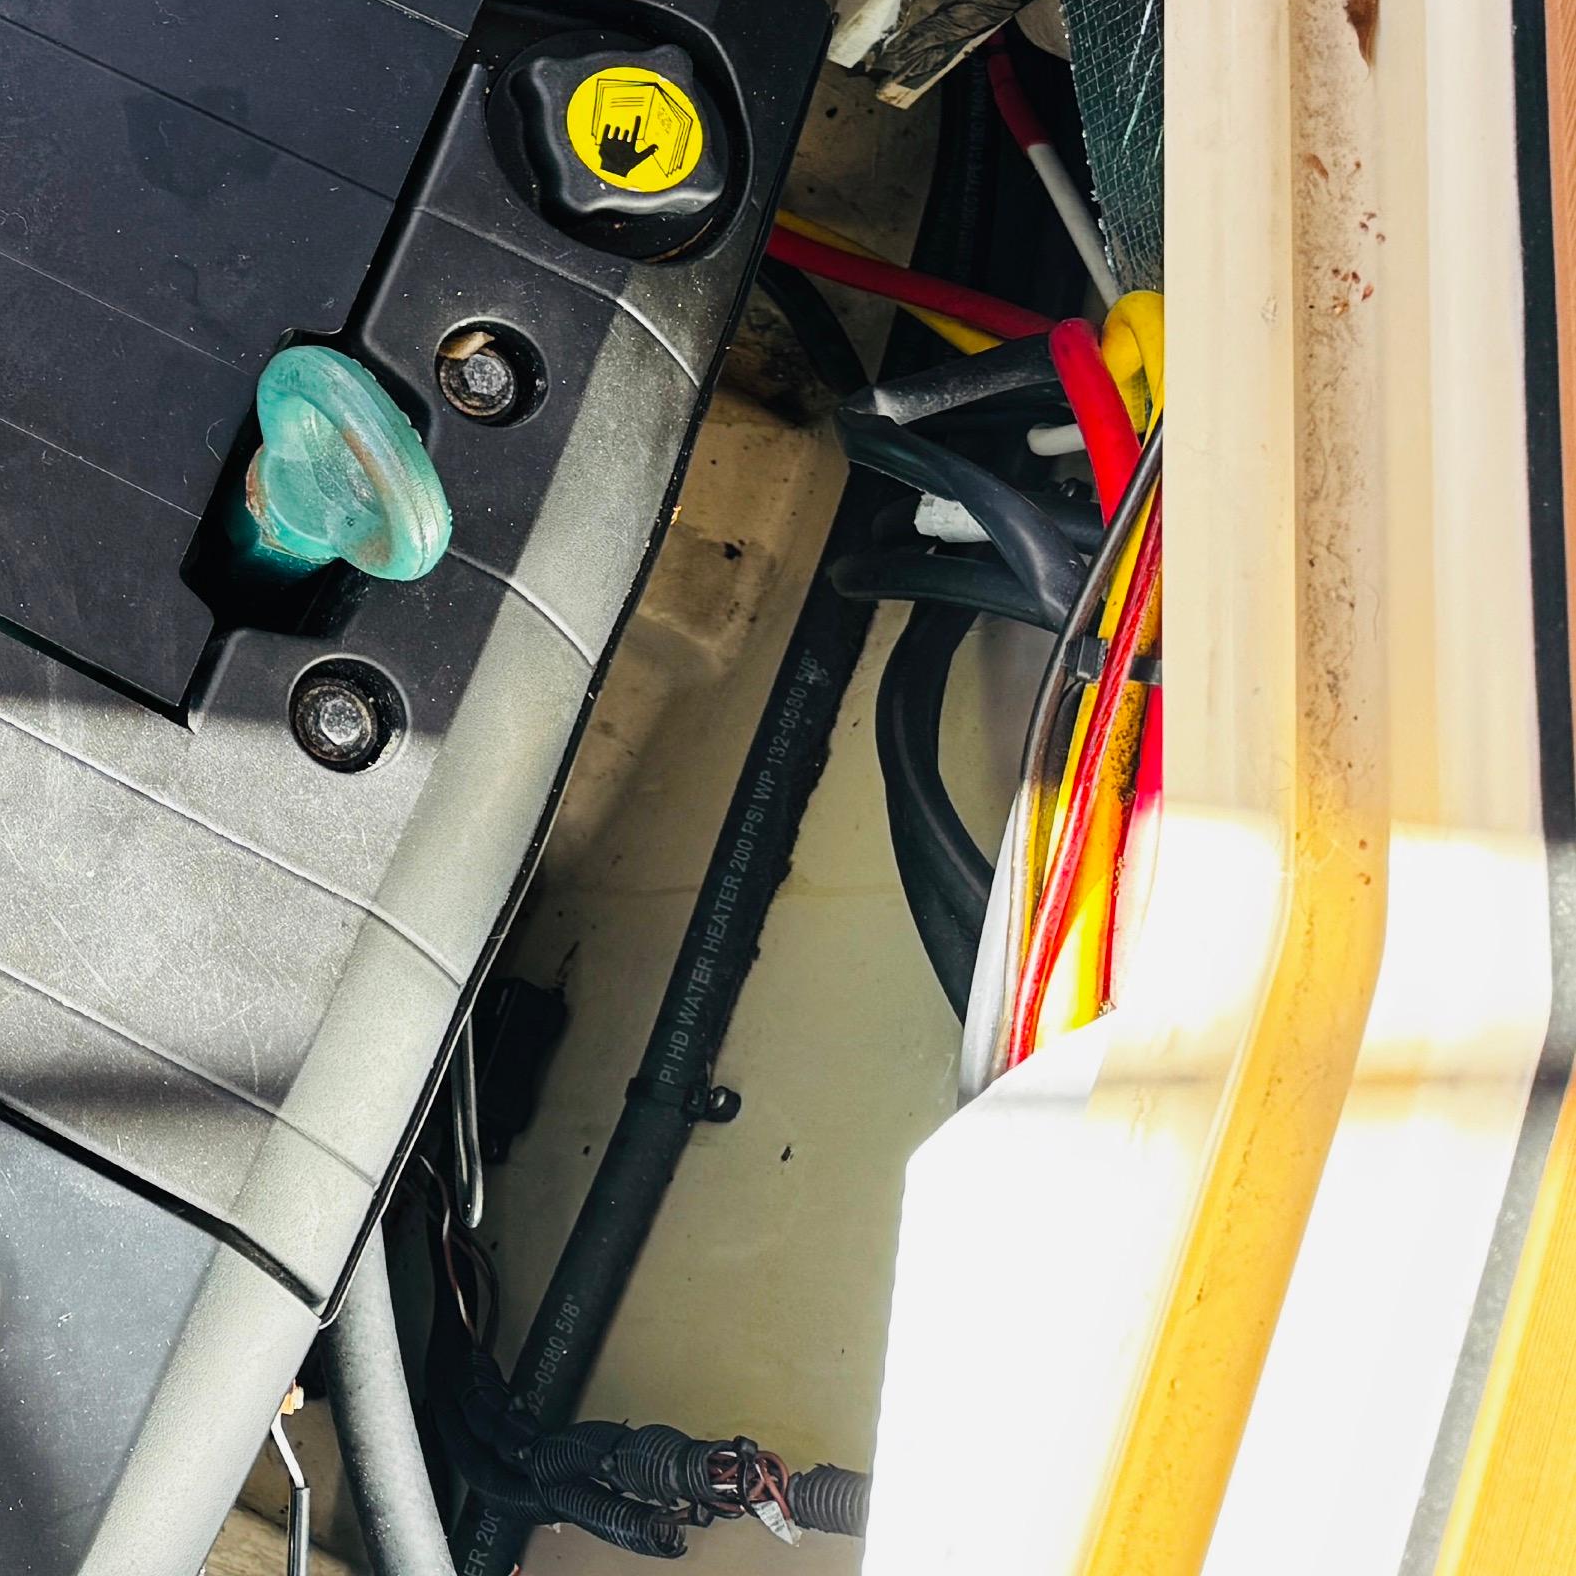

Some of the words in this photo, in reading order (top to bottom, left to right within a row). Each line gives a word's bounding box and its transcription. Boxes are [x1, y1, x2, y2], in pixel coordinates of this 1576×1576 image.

[752, 768, 779, 803] WP
[741, 804, 767, 836] PSI
[728, 837, 756, 872] 200
[700, 874, 743, 952] HEATER
[675, 959, 715, 1028] WATER
[665, 1029, 691, 1060] HD
